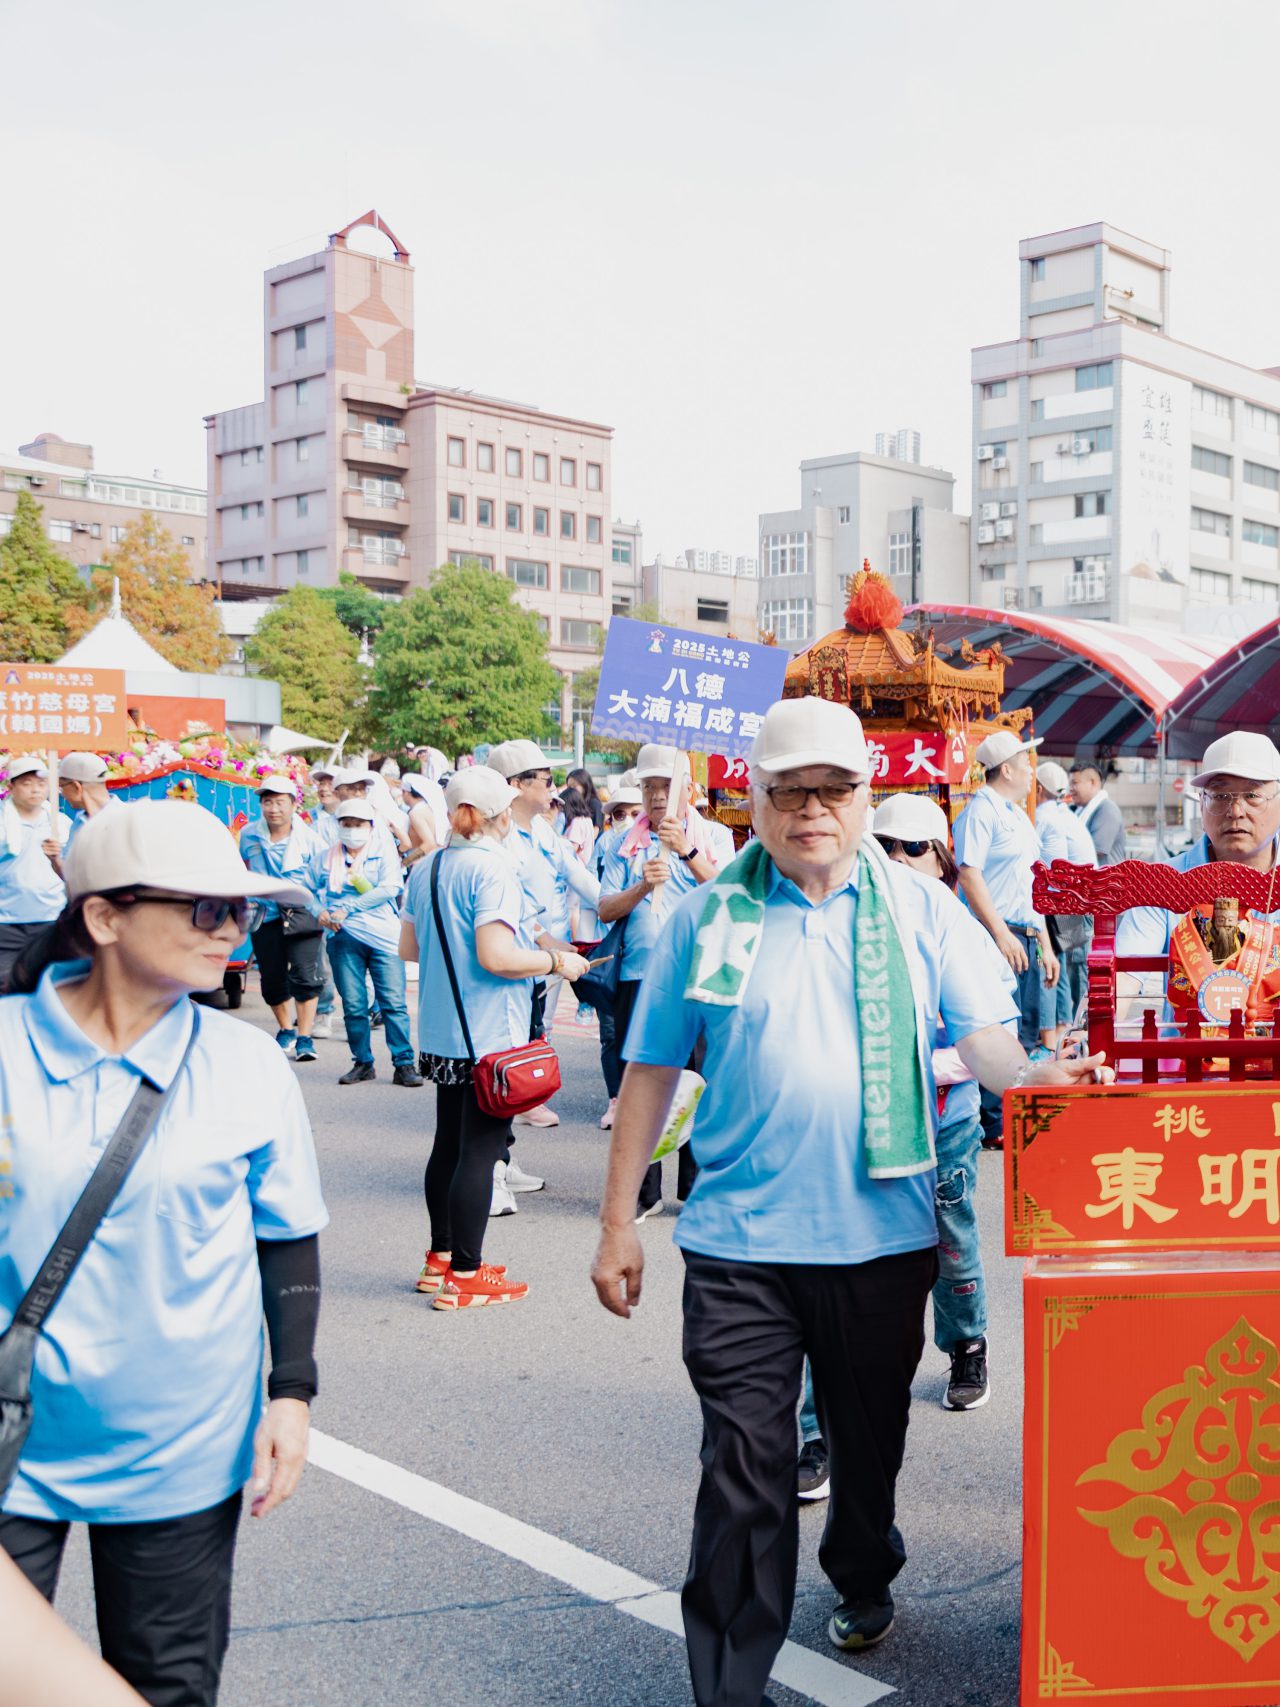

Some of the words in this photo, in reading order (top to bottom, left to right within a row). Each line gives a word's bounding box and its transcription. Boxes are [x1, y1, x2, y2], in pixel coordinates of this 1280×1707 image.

[661, 667, 726, 701] 八德
[607, 689, 767, 739] 大湳福成宮
[1214, 996, 1241, 1011] 1-5
